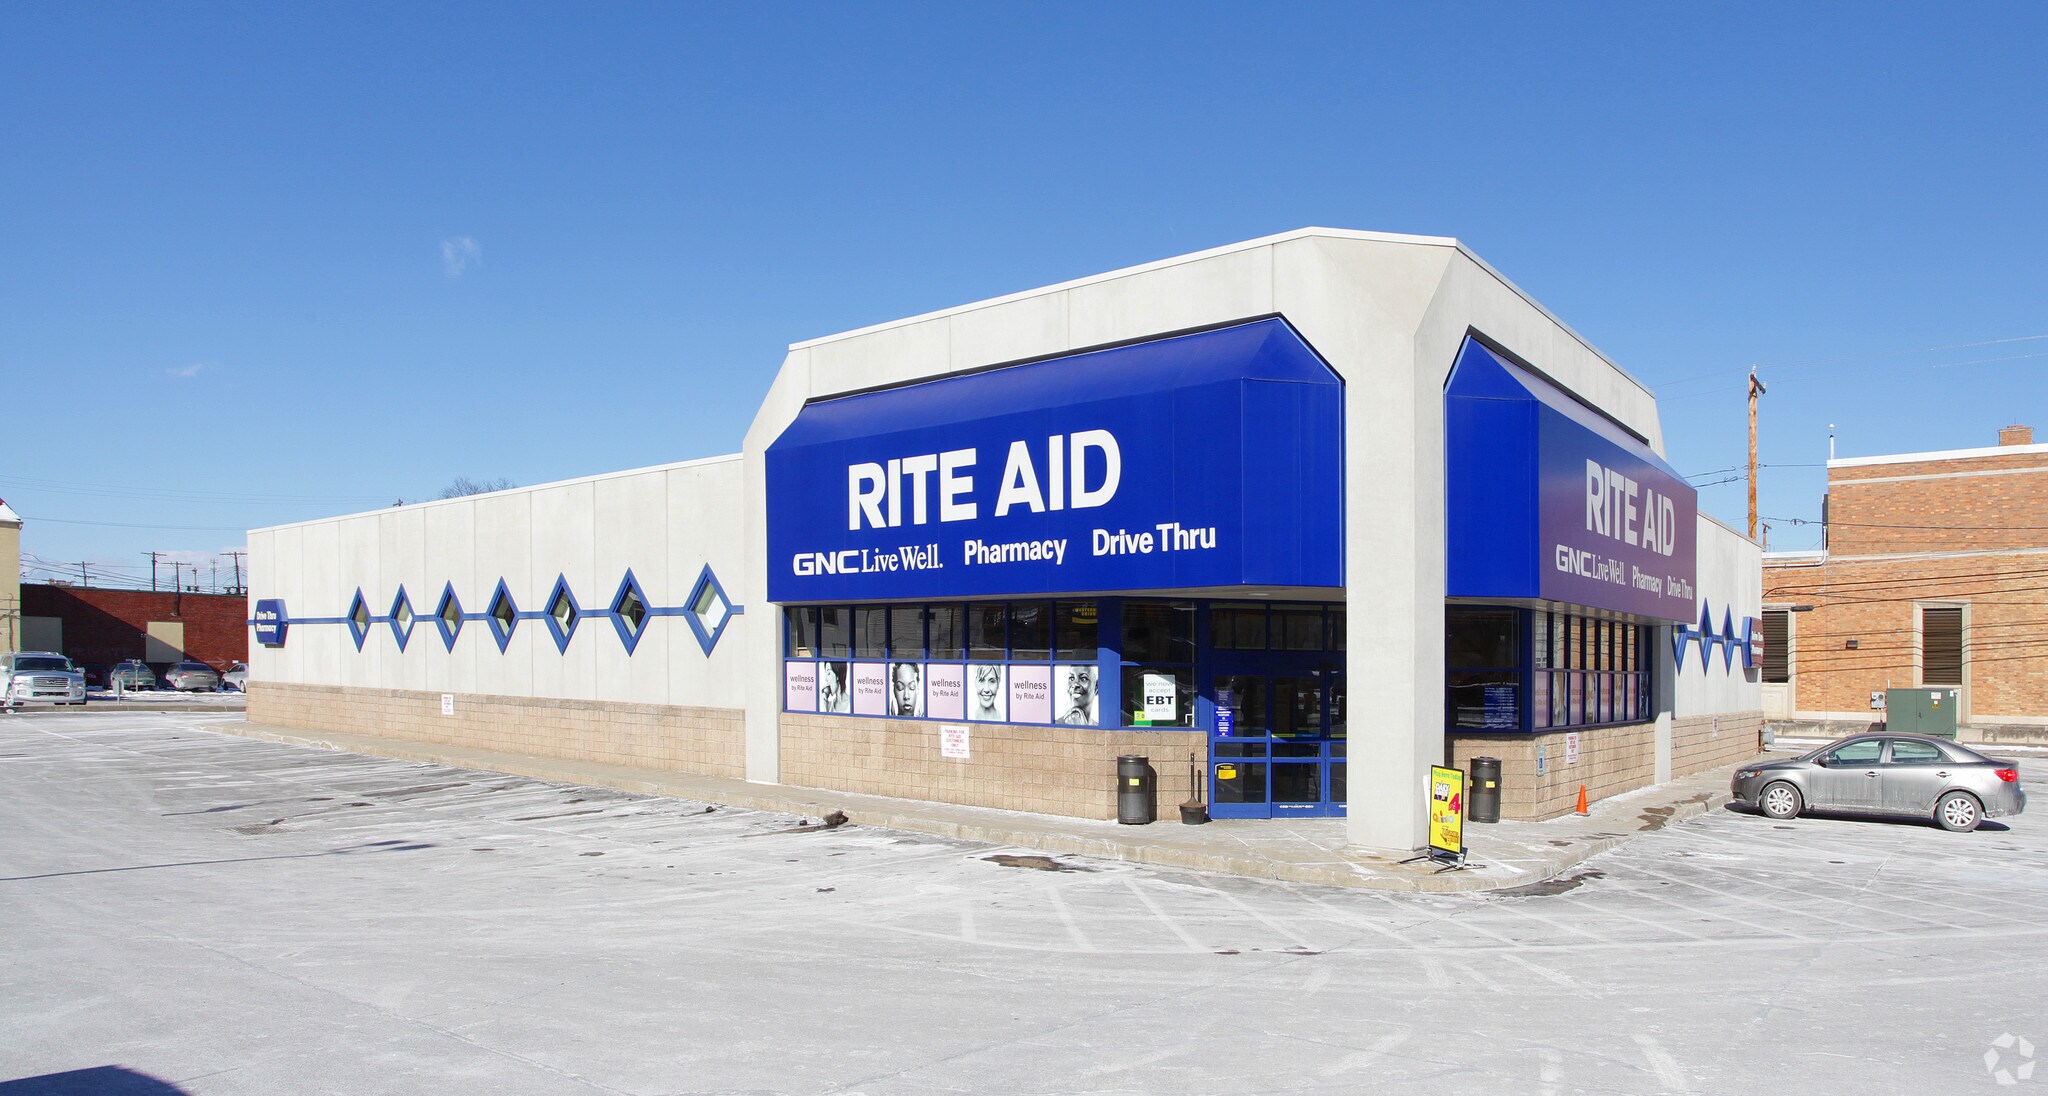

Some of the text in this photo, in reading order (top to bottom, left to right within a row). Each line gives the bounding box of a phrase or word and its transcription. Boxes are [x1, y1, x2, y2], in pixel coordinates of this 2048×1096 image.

[848, 429, 1122, 531] RITE AID
[1586, 458, 1675, 557] RITE AID
[792, 522, 1216, 576] GNC Live Well. Pharmacy Drive Thru
[1556, 544, 1592, 578] GNC
[1592, 554, 1609, 581] Live
[1632, 565, 1662, 598] Pharmacy
[1668, 576, 1681, 598] Drive
[1681, 578, 1693, 600] Thru
[256, 611, 277, 620] Drive Thru
[256, 623, 277, 634] Pharmacy
[790, 675, 814, 683] wellness
[857, 677, 884, 685] wellness
[931, 679, 961, 688] wellness
[1014, 680, 1047, 690] wellness
[1146, 696, 1174, 705] EBT
